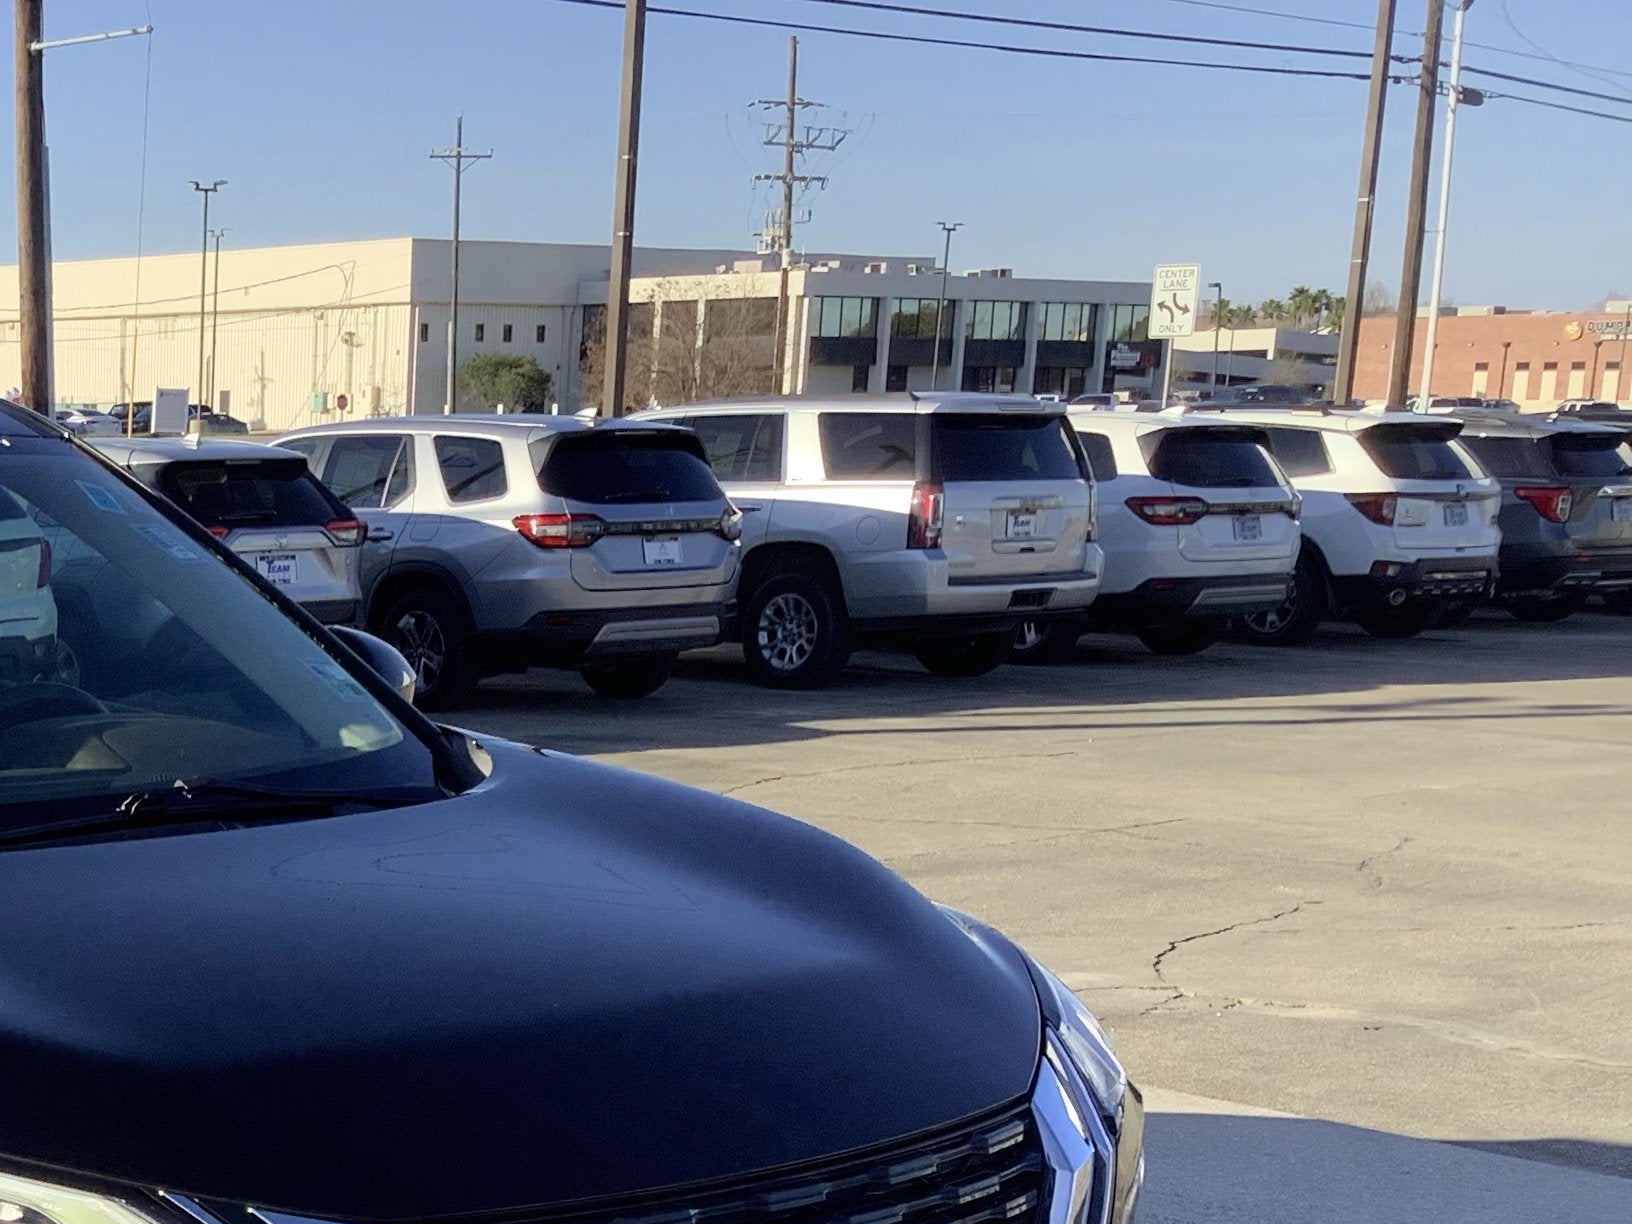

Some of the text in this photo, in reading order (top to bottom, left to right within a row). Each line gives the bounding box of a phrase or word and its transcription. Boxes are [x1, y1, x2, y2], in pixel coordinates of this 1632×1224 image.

[1159, 269, 1195, 279] CENTER
[1163, 279, 1189, 289] LANE
[1159, 324, 1184, 333] ONLY
[266, 560, 290, 573] TEAM
